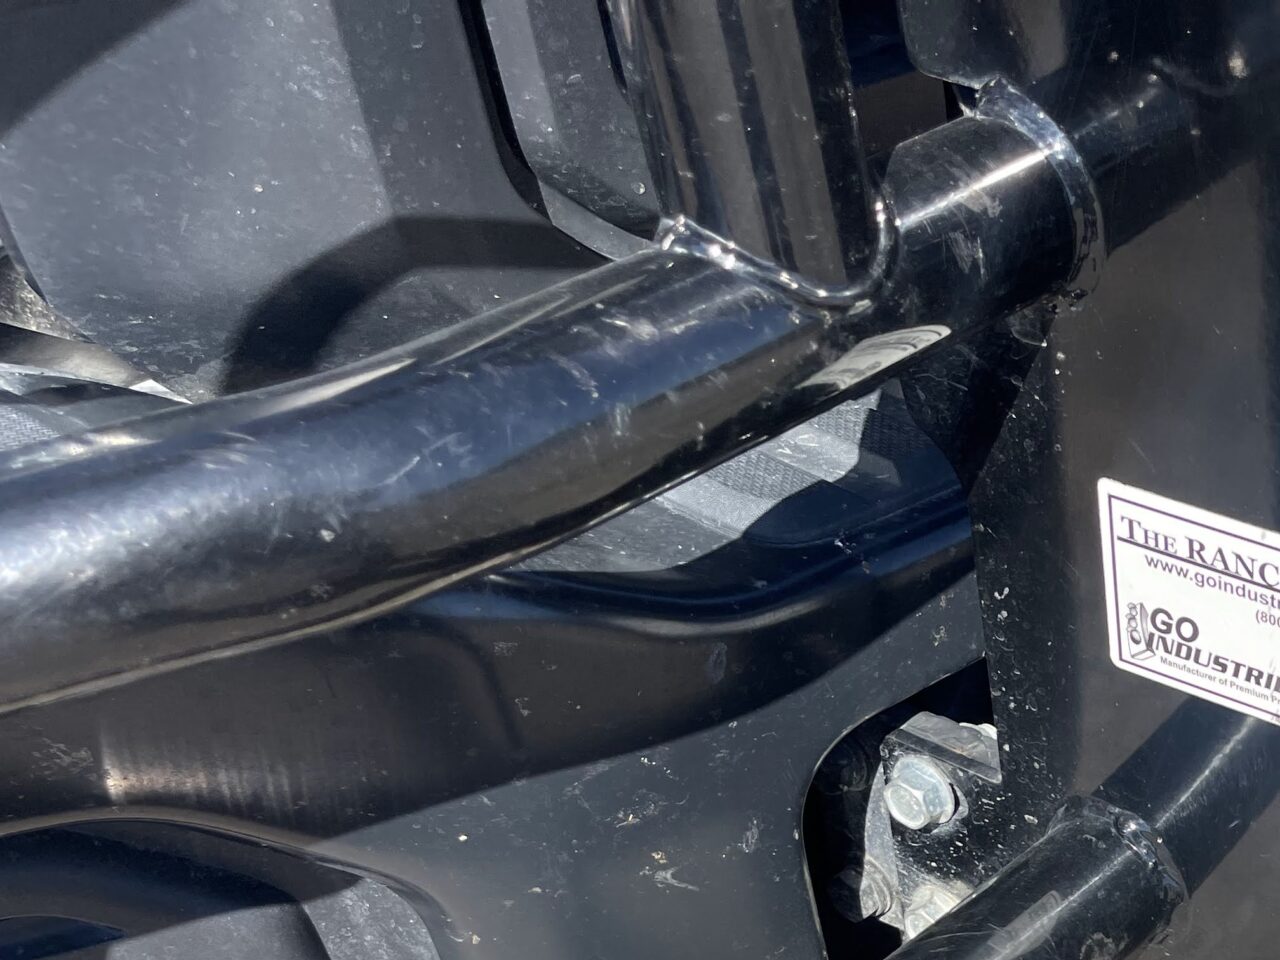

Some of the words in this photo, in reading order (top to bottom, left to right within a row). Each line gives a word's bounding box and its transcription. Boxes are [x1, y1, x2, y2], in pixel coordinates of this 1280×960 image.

[1150, 607, 1200, 643] GO
[1160, 656, 1217, 682] Manufacturer
[1218, 678, 1228, 687] of
[1229, 680, 1270, 701] Premium
